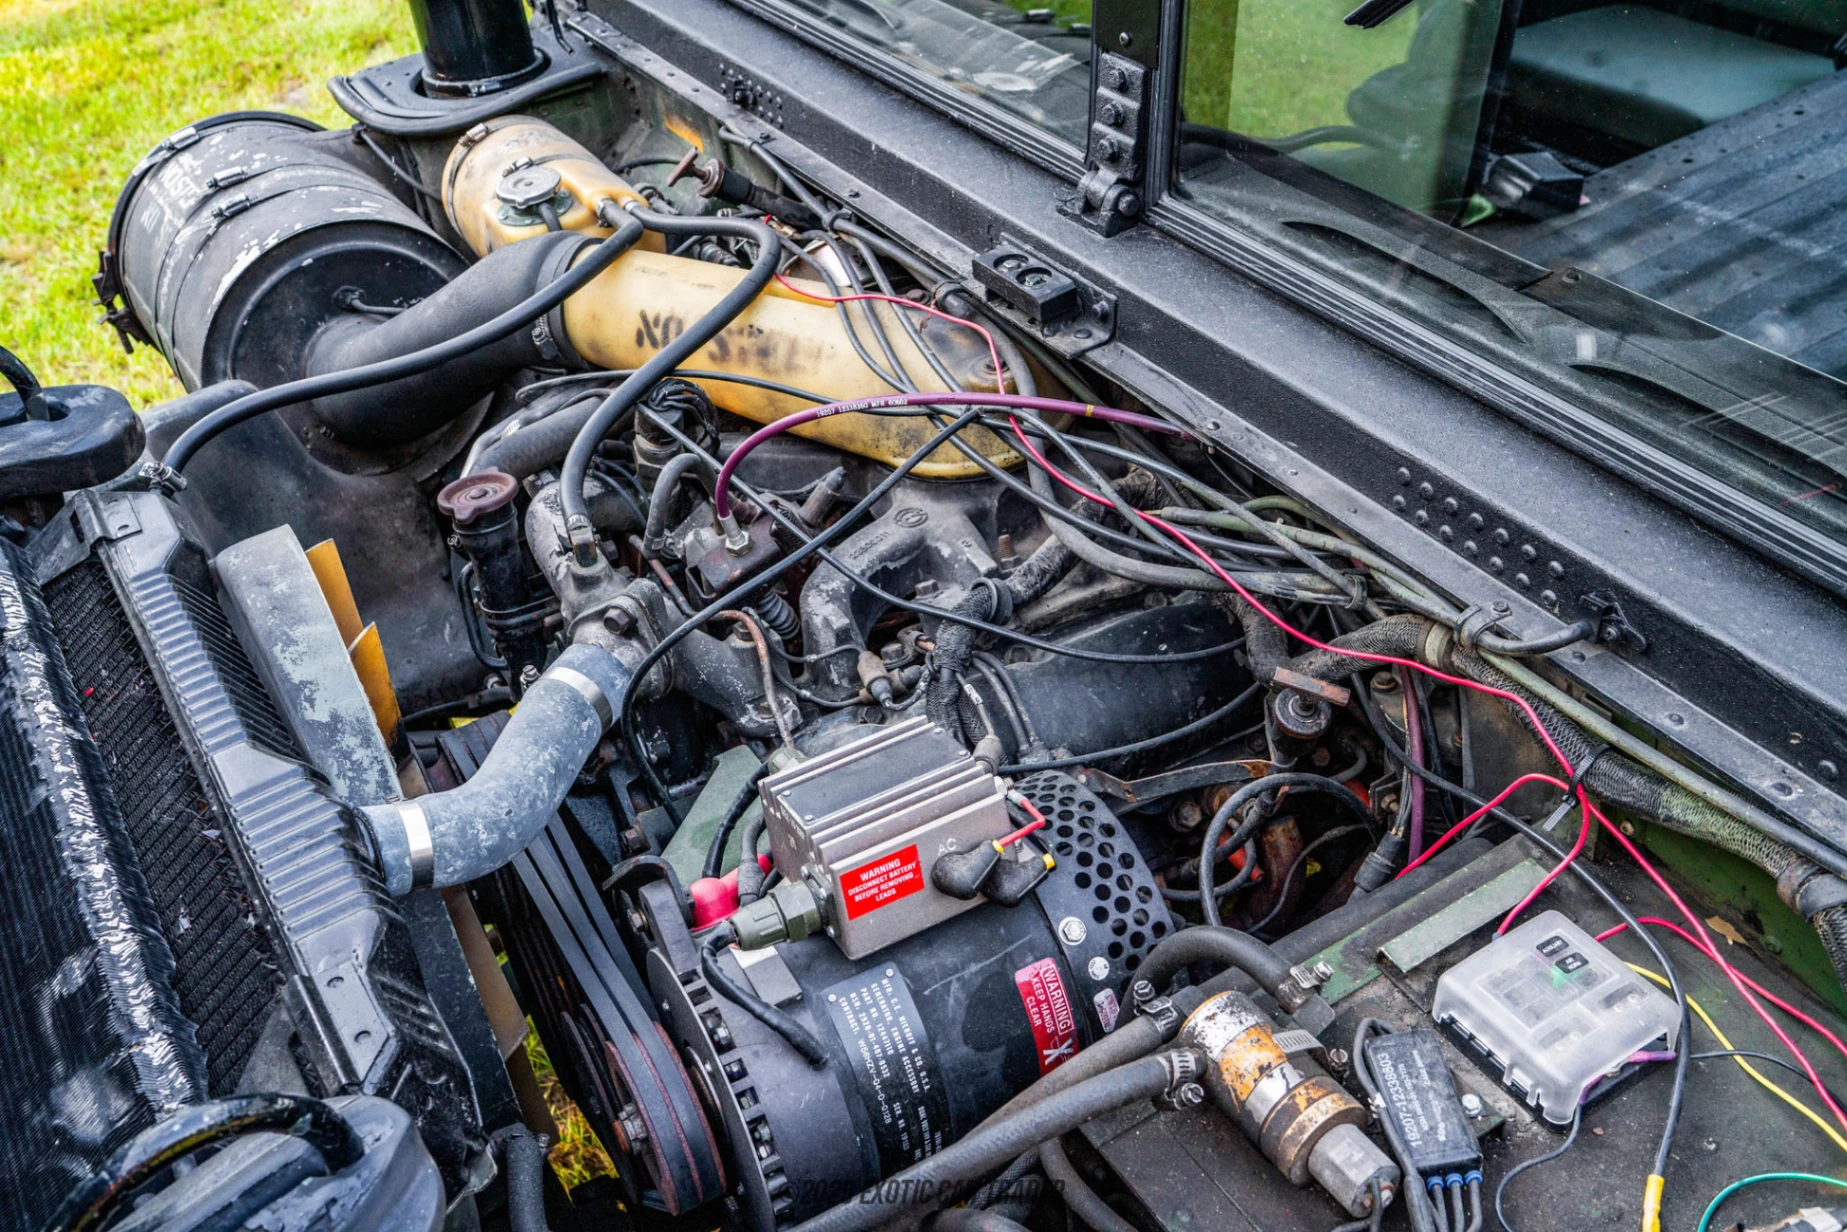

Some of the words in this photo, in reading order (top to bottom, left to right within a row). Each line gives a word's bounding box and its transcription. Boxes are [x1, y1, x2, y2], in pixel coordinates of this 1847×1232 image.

[937, 838, 957, 856] AC
[848, 874, 888, 896] DISCONNECT
[889, 861, 916, 879] BATTERY
[860, 858, 901, 882] WARNING
[854, 887, 879, 902] BEFORE
[880, 872, 914, 891] REMOVING
[875, 888, 896, 902] LEADS
[860, 987, 872, 1005] PART
[1031, 977, 1046, 1001] KEEP
[1040, 1002, 1056, 1034] HANDS
[1044, 968, 1072, 1030] WARNING
[1026, 996, 1042, 1027] CLEAR
[890, 1027, 907, 1053] ENGINE
[901, 1055, 920, 1094] ACCESSORY
